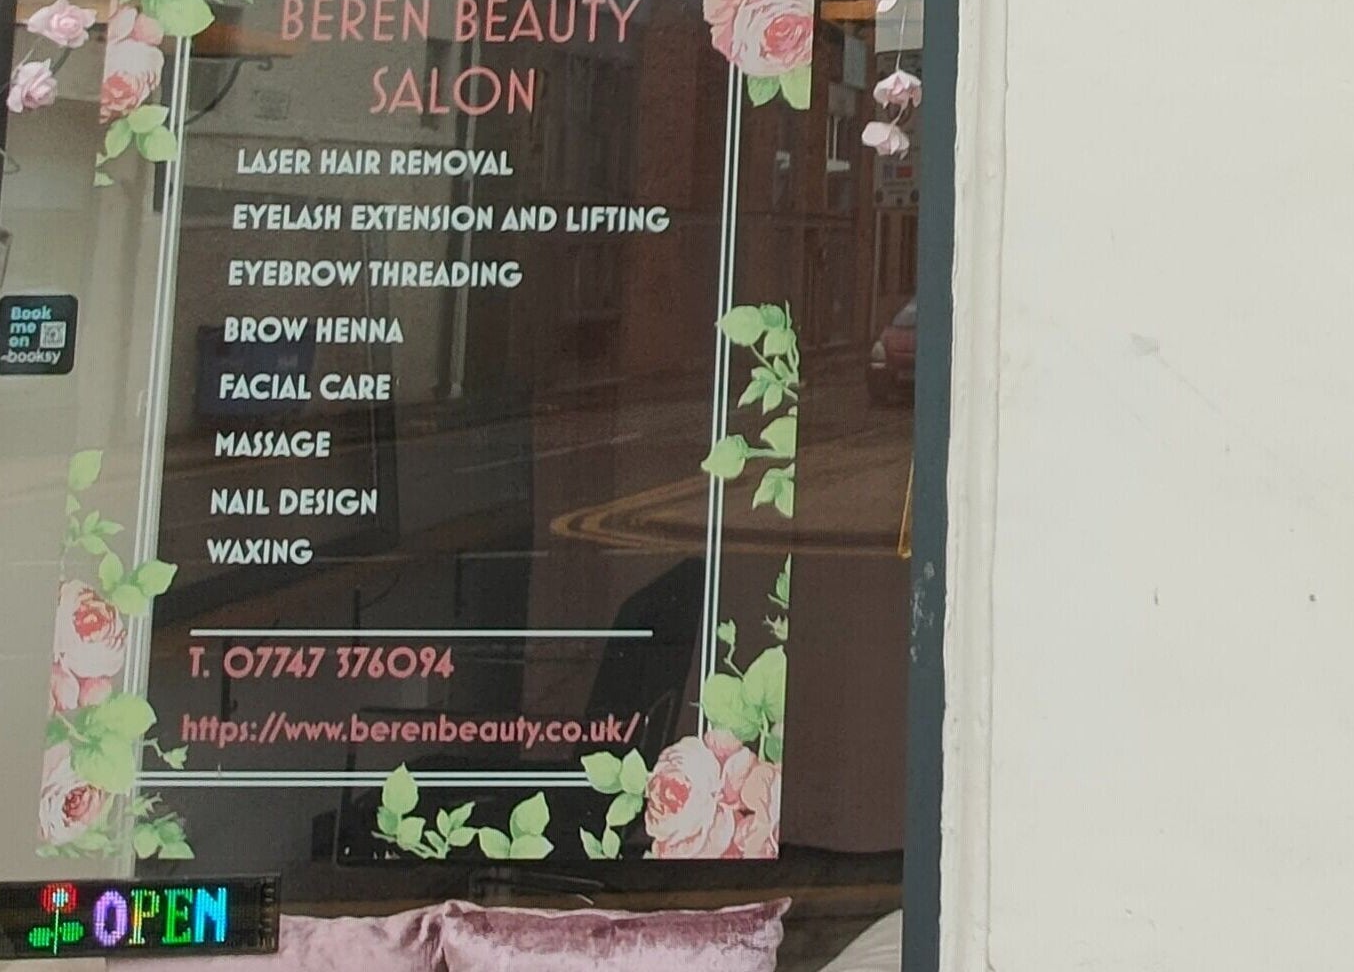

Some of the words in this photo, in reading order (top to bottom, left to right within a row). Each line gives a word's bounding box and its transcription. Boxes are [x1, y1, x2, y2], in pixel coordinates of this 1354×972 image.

[369, 65, 536, 115] SALON
[237, 148, 310, 175] LASER
[320, 149, 380, 175] HAIR
[389, 150, 513, 176] REMOVAL
[232, 204, 341, 231] EYELASH
[351, 204, 494, 232] EXTENSION
[501, 205, 557, 232] AND
[565, 206, 671, 233] LIFTING
[228, 260, 362, 287] EYEBROW
[368, 260, 523, 288] THREADING
[11, 305, 52, 320] Book
[10, 322, 37, 334] me
[223, 316, 307, 343] BROW
[315, 317, 404, 343] HENNA
[9, 336, 30, 348] on
[7, 348, 62, 365] booksy
[219, 374, 312, 400] FACIAL
[320, 374, 391, 400] CARE
[214, 431, 331, 458] MASSAGE
[210, 488, 270, 515] NAIL
[279, 488, 378, 516] DESIGN
[207, 539, 314, 565] WAXING
[189, 647, 210, 678] T.
[223, 647, 325, 679] 07747
[336, 646, 454, 679] 376094
[182, 711, 641, 748] https://www.berenbeauty.co.uk/
[93, 886, 228, 948] OPEN
